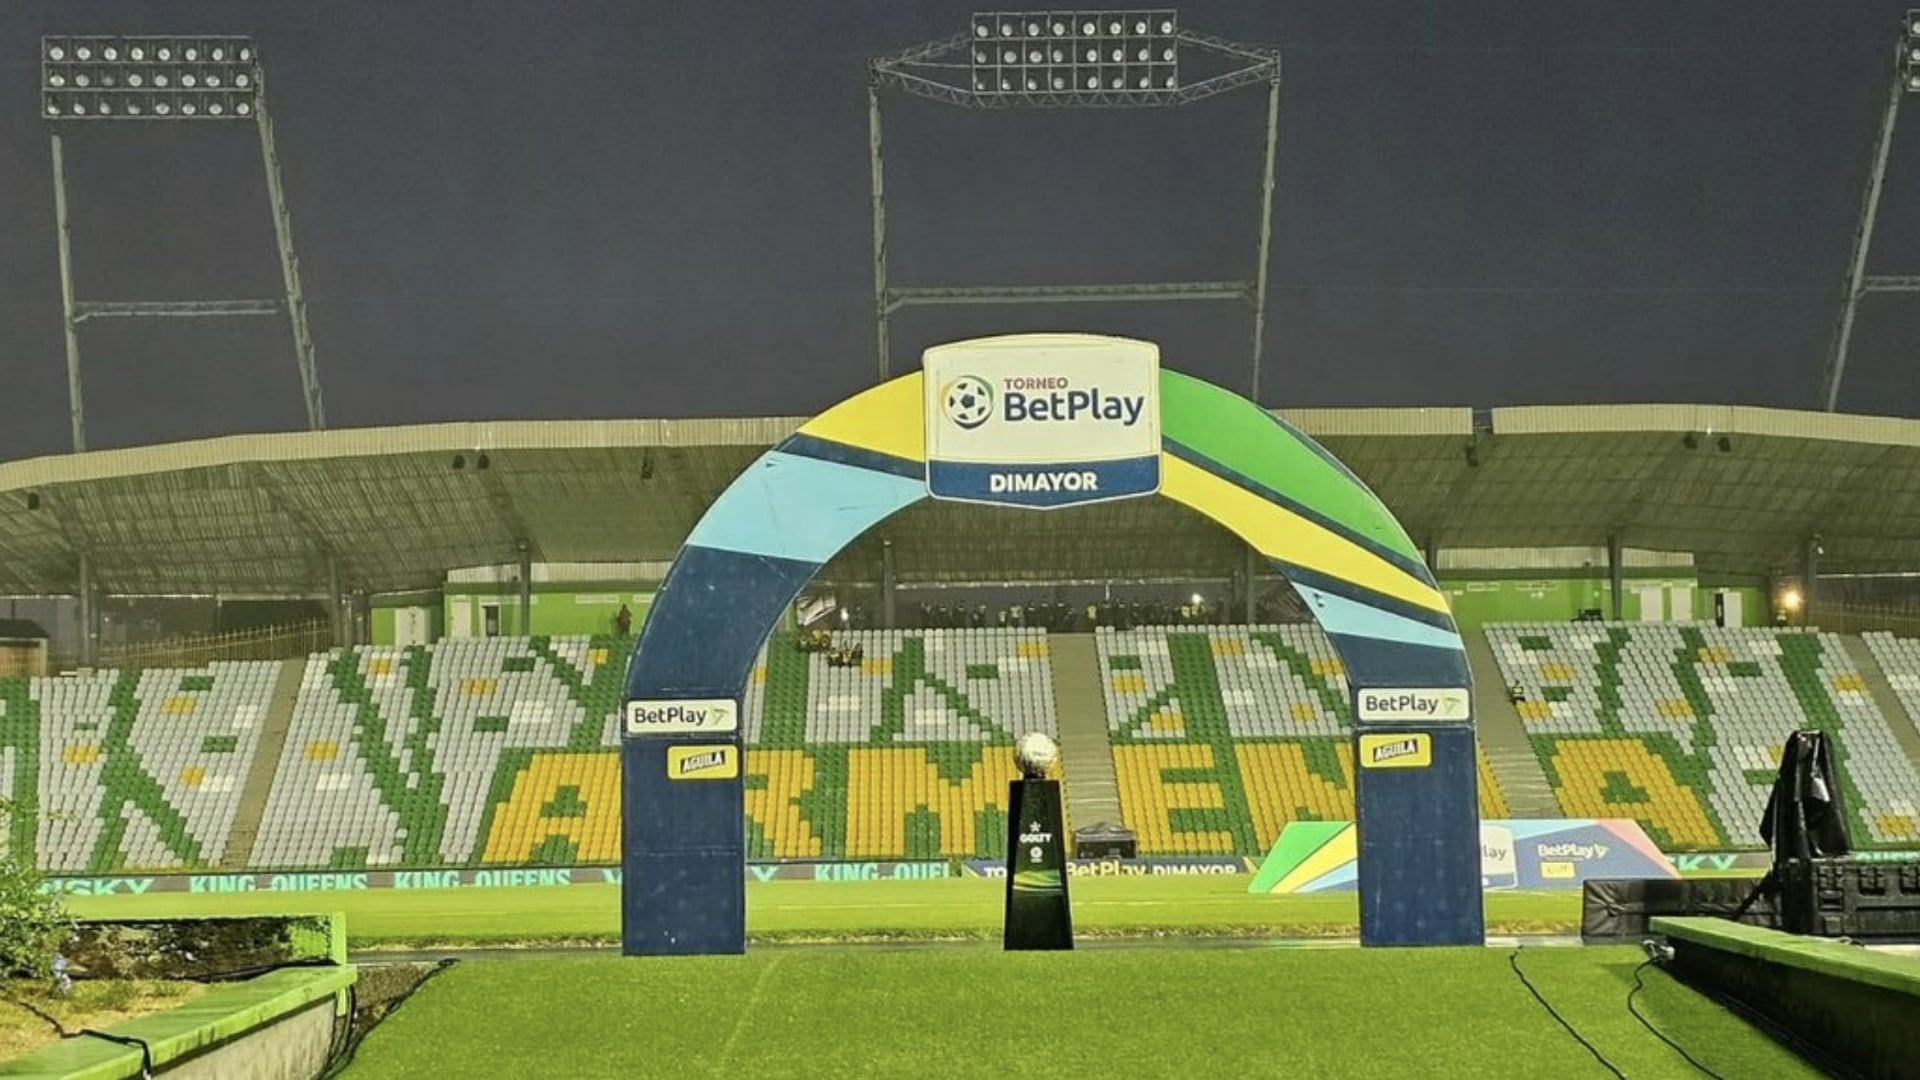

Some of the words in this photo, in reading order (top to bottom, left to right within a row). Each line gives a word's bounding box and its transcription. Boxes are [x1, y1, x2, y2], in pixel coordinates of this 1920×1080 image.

[1004, 377, 1068, 390] TORNEO
[1004, 388, 1144, 426] BetPlay
[990, 472, 1098, 493] DIMAYOR
[1366, 693, 1438, 715] BetPlay
[635, 706, 707, 726] BetPlay
[1374, 739, 1418, 762] AGUILA
[1538, 843, 1593, 859] BetPlay
